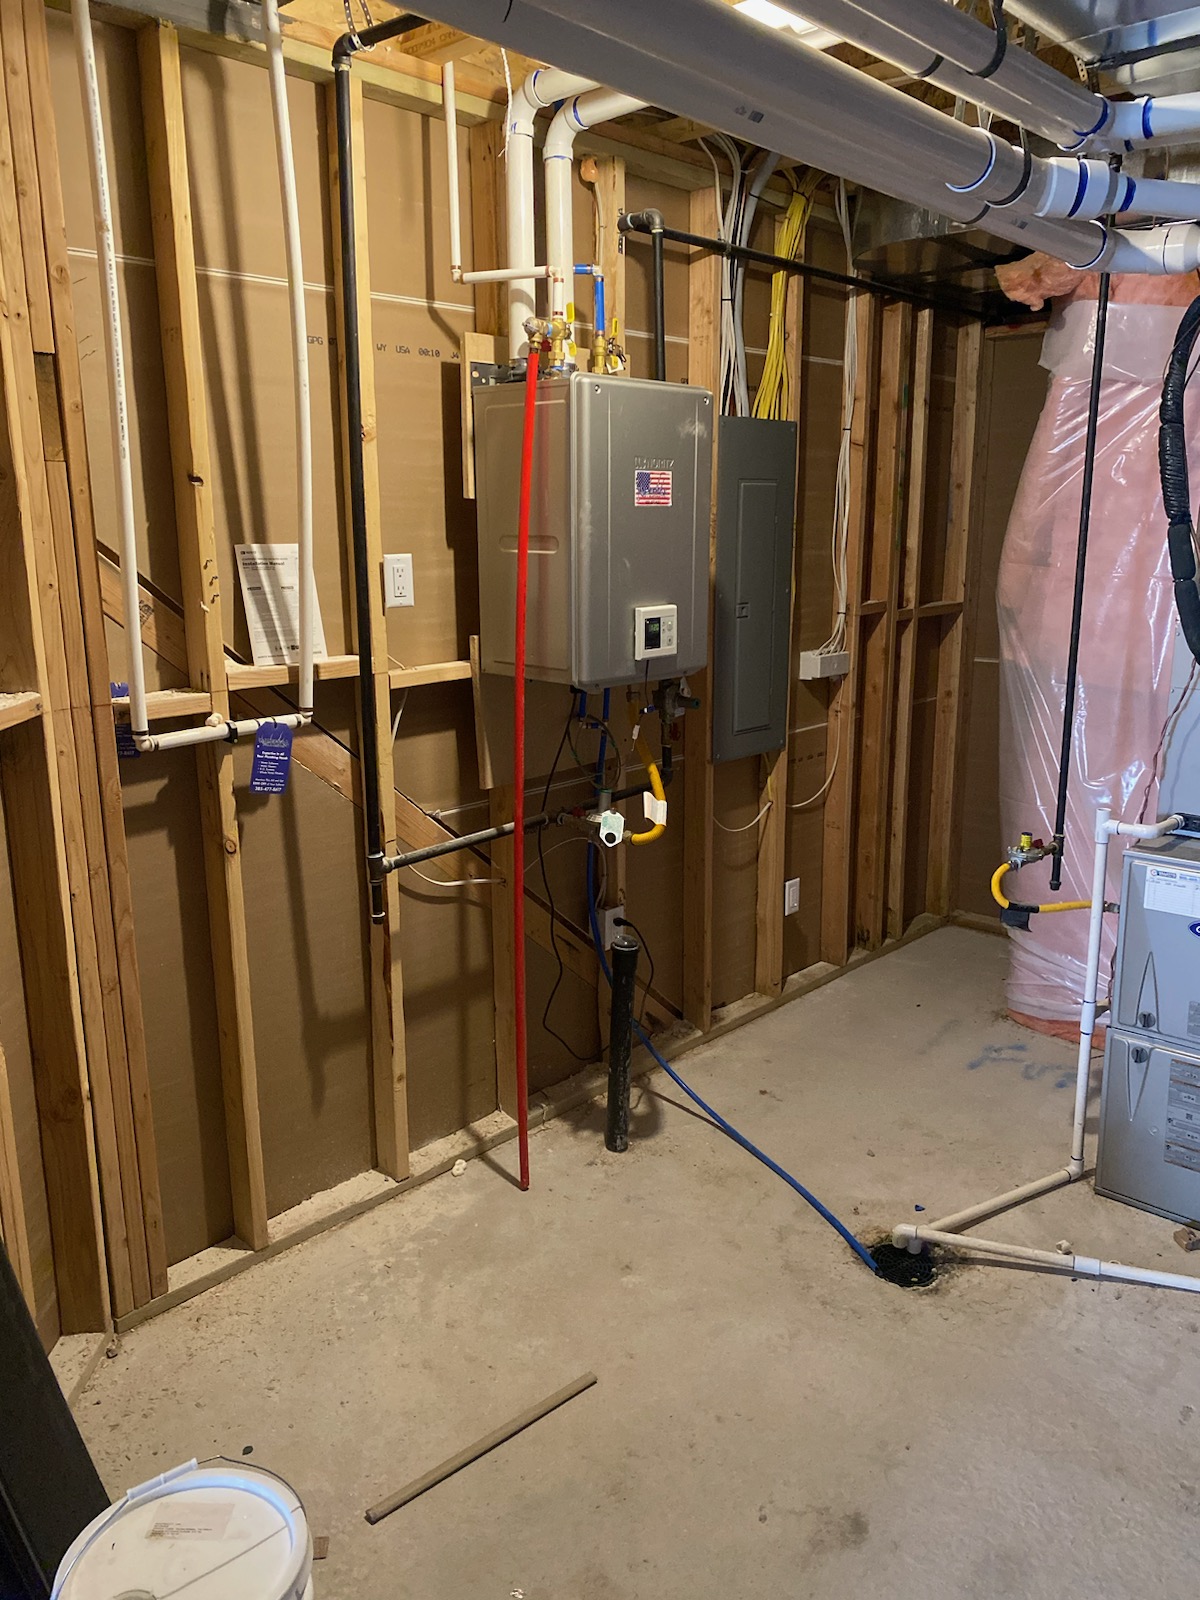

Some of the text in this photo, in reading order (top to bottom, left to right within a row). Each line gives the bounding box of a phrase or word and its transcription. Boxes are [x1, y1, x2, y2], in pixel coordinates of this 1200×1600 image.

[376, 343, 387, 352] WY
[395, 345, 411, 354] USA
[418, 347, 441, 358] 00:10
